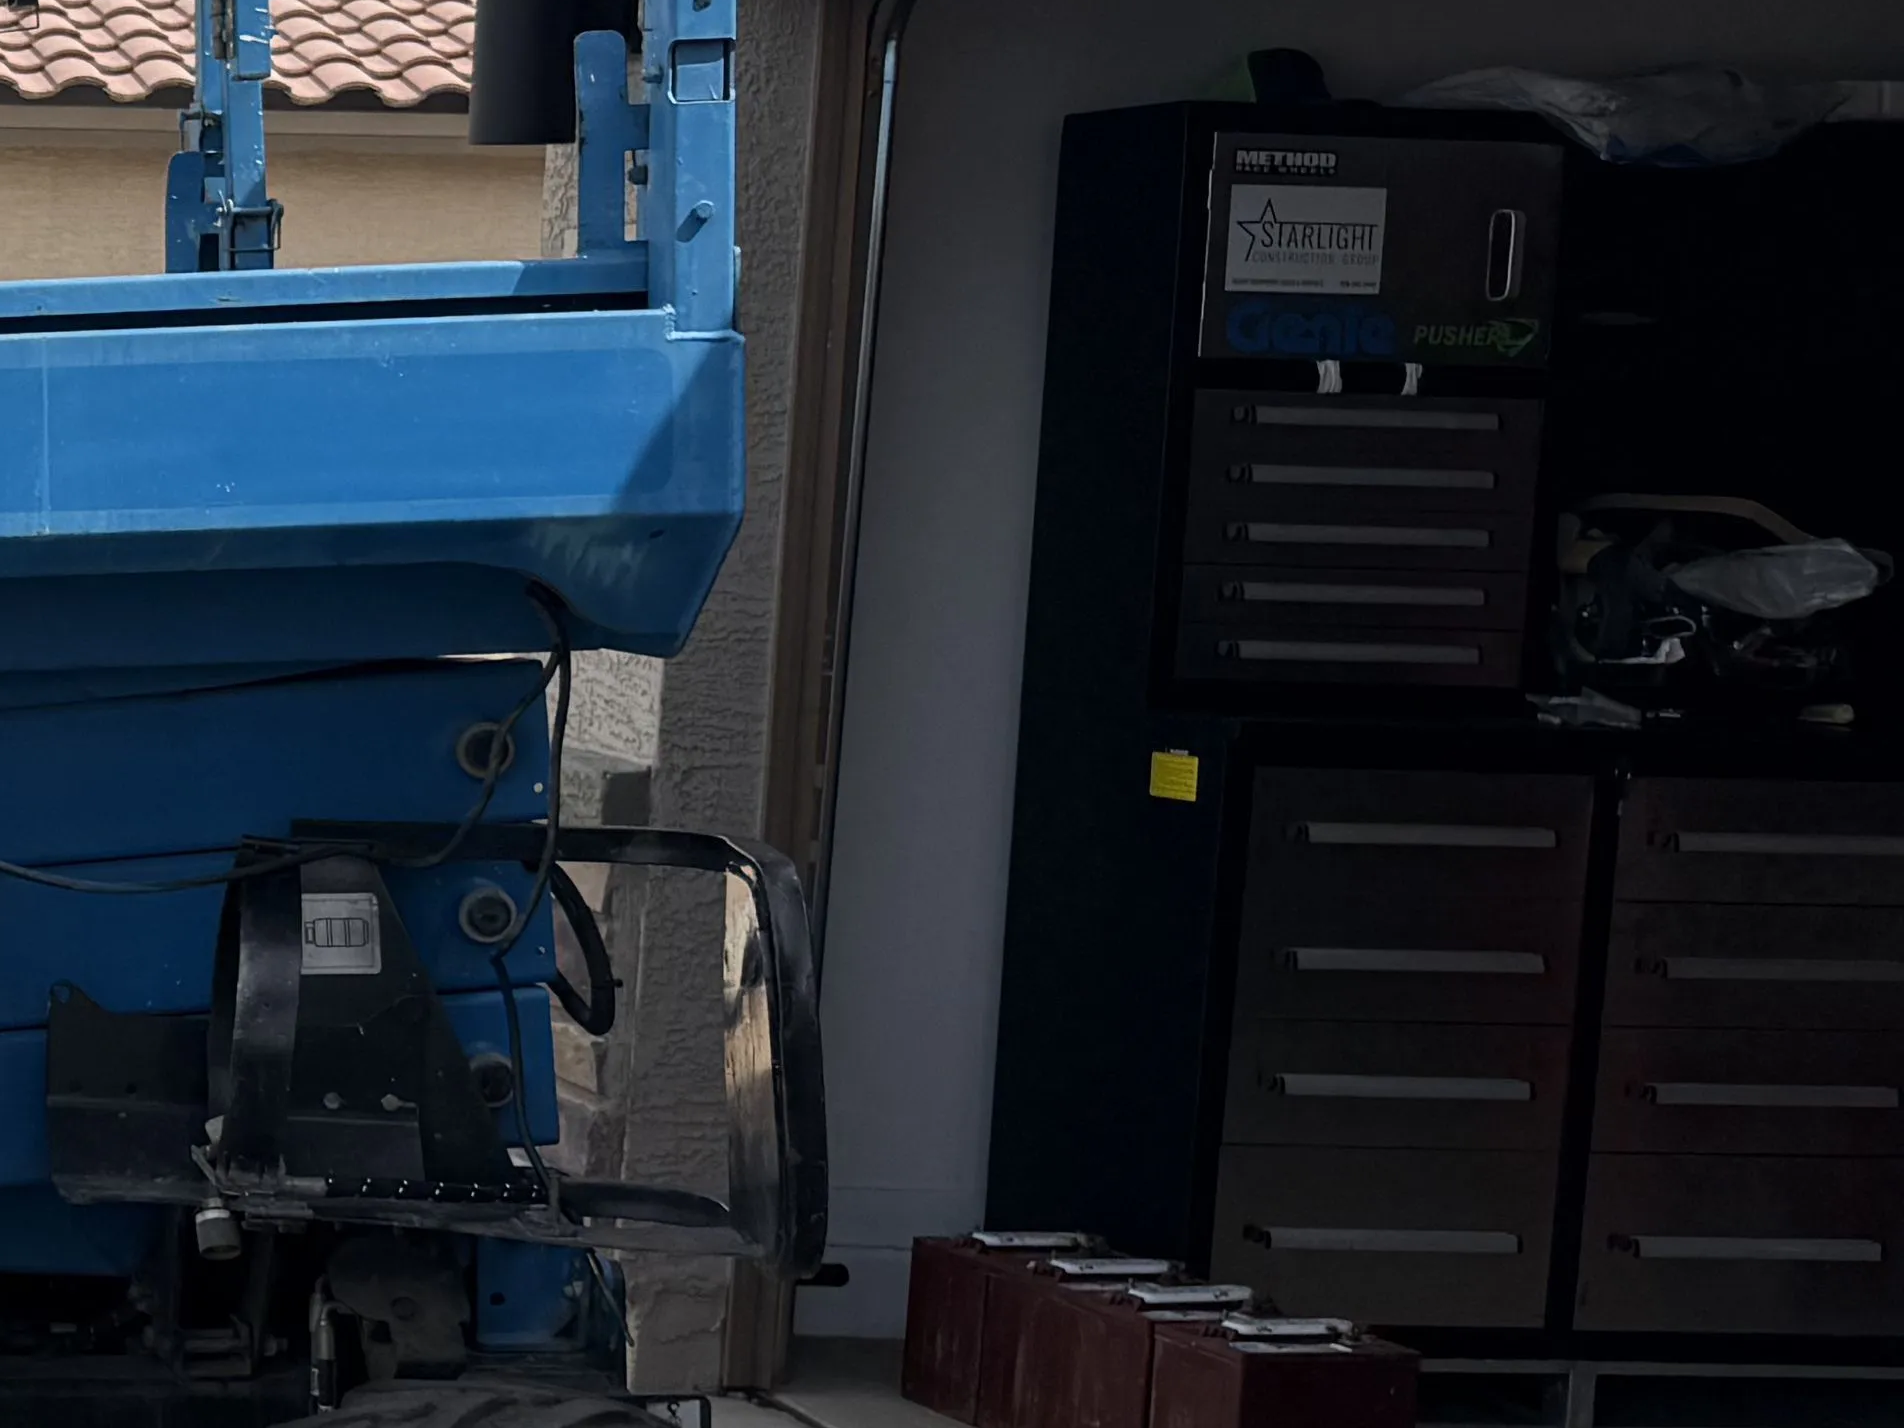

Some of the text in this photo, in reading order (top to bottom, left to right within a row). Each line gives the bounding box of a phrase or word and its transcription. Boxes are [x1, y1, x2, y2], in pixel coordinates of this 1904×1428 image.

[1235, 149, 1337, 168] METHOD
[1261, 220, 1379, 251] STARLIGHT
[1251, 251, 1380, 267] CONSTRUCTION GROUP
[1226, 302, 1397, 355] Genie
